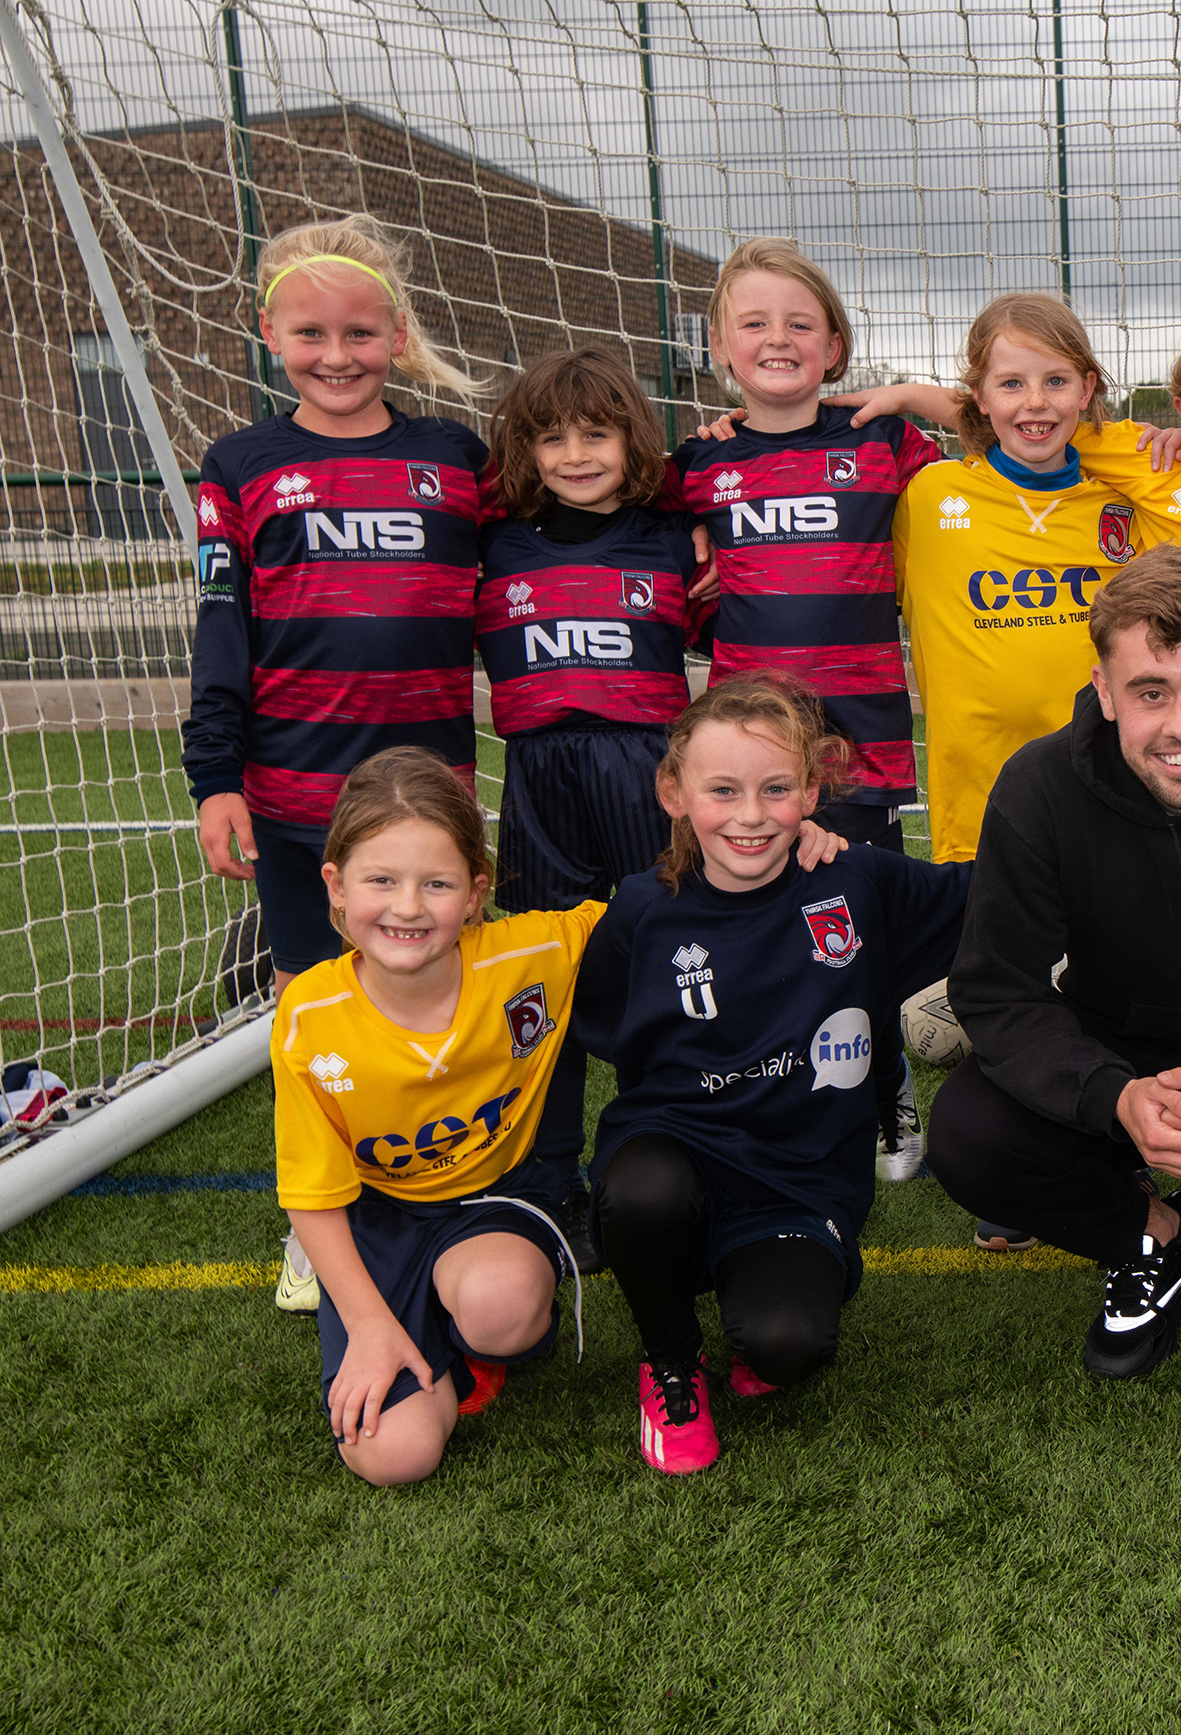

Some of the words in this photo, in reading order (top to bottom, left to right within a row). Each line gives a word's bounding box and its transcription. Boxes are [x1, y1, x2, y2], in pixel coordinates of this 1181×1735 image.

[276, 492, 315, 509] errea
[713, 489, 741, 503] errea
[730, 496, 839, 537] NTS
[939, 517, 970, 529] errea
[304, 512, 426, 550] NTS
[733, 535, 763, 545] National
[785, 531, 839, 540] Stockholders
[308, 551, 343, 559] National
[369, 551, 426, 559] Stockholders
[968, 567, 1101, 611] CST
[508, 602, 535, 618] errea
[974, 616, 1024, 629] CLEVELAND
[1027, 615, 1057, 627] STEEL
[1059, 614, 1067, 624] &
[524, 620, 633, 662] NTS
[527, 660, 558, 671] National
[580, 658, 633, 667] Stockholders
[676, 968, 714, 988] errea
[819, 1031, 870, 1063] info
[918, 1026, 937, 1056] mitre
